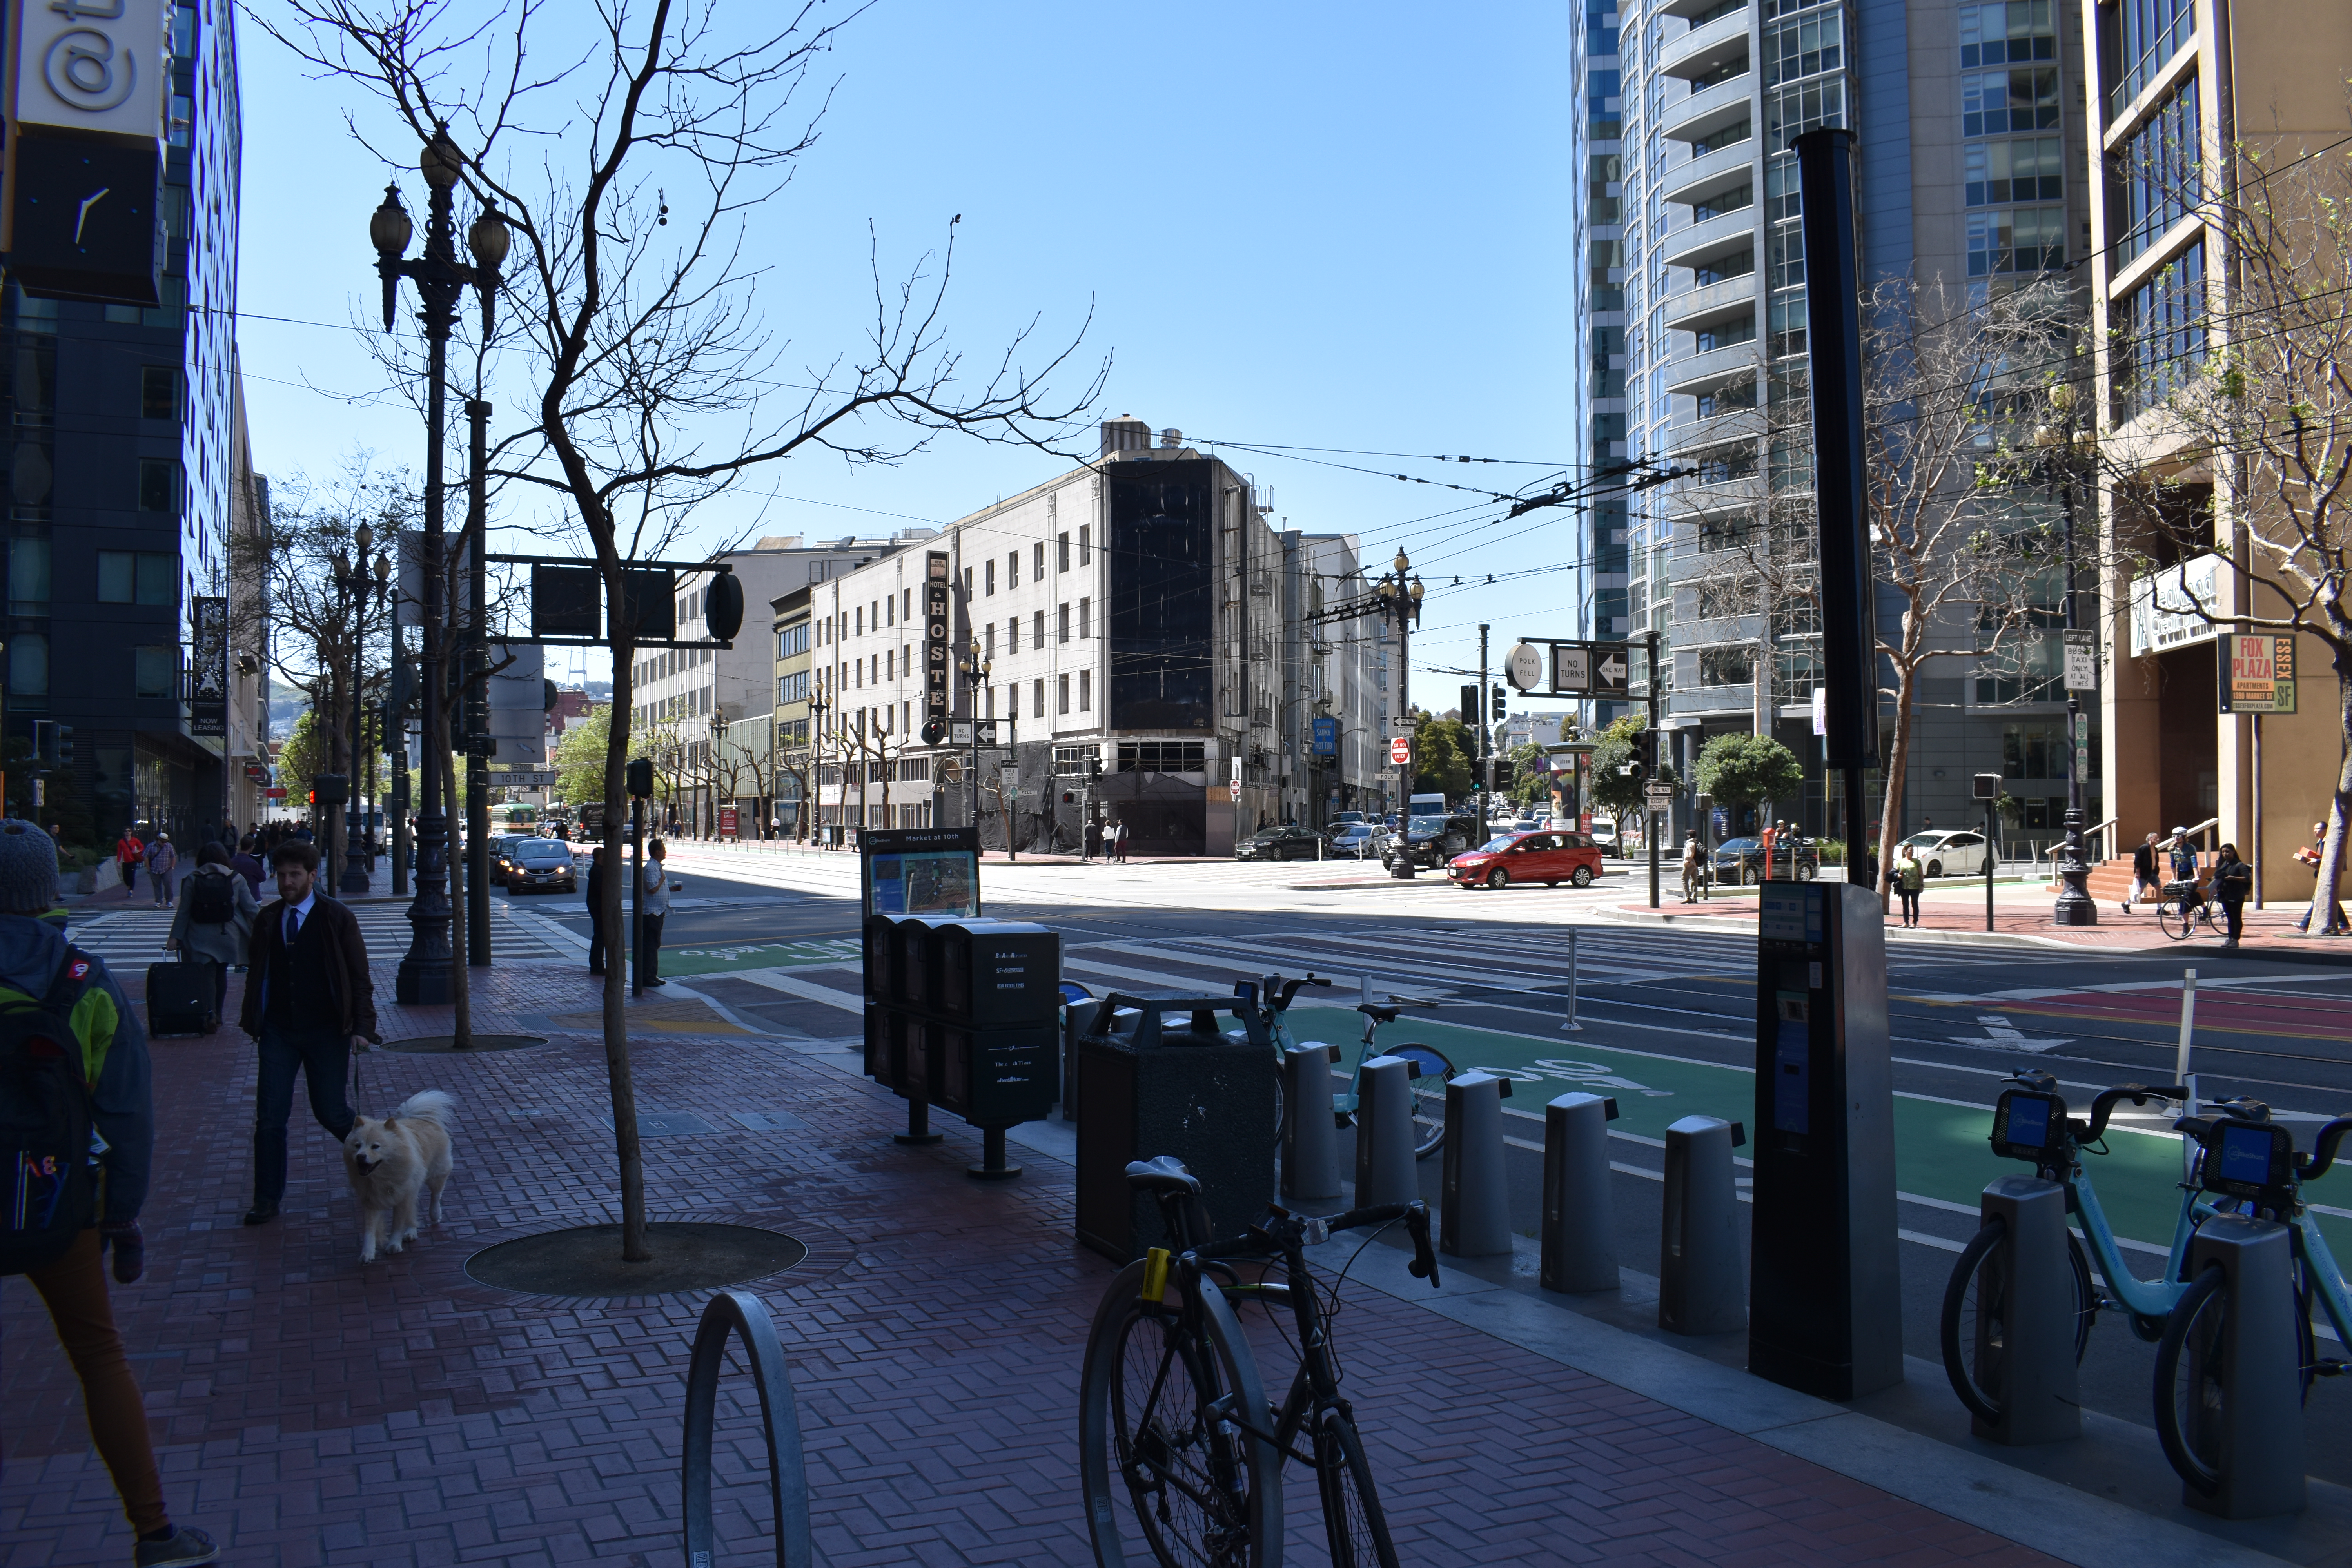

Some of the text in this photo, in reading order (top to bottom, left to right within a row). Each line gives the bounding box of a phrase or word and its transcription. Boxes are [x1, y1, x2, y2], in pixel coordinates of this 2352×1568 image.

[2152, 567, 2212, 612] edwood
[2152, 614, 2180, 636] Credit
[2240, 637, 2264, 658] FOX
[1568, 660, 1577, 668] NO
[2232, 658, 2272, 679] PLAZA
[2276, 638, 2292, 679] ESSEX
[1561, 670, 1585, 678] TURNS
[2277, 686, 2291, 706] SF
[501, 774, 544, 783] 10TH ST
[2022, 1118, 2044, 1127] BikeShare
[2238, 1151, 2265, 1161] BikeShare
[1262, 1216, 1276, 1231] ROAM
[2083, 1188, 2119, 1269] BayAreaBikeShare
[2307, 1231, 2352, 1324] BayAreaBikeShar
